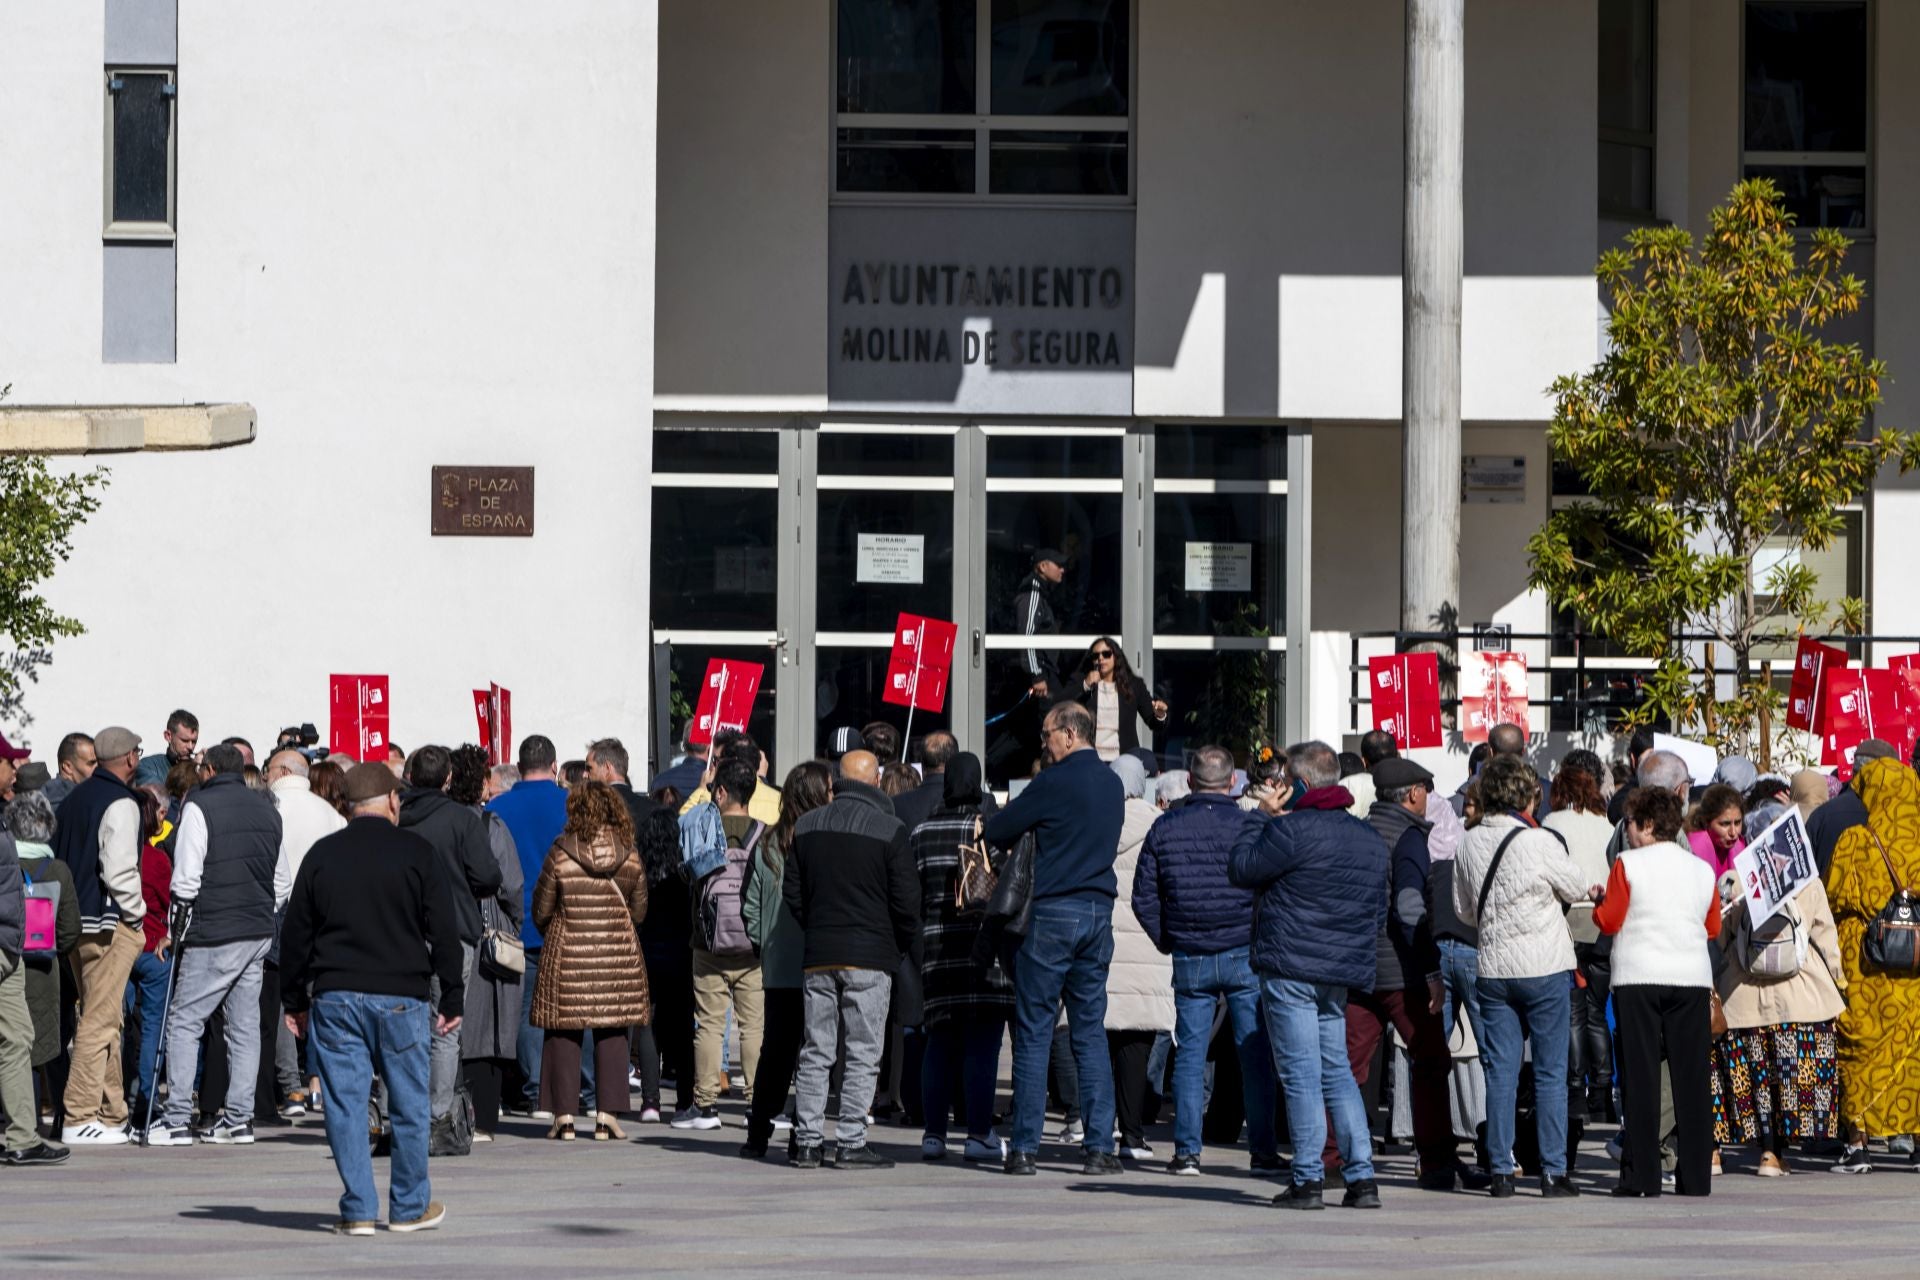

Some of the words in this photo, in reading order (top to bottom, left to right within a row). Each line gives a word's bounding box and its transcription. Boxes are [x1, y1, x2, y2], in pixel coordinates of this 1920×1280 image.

[843, 265, 1121, 308] AYUNTAMIENTO
[842, 328, 950, 362] MOLINA
[963, 331, 997, 366] DE
[1011, 331, 1120, 366] SEGURA
[468, 478, 518, 492] PLAZA
[480, 496, 500, 510] DE
[462, 512, 525, 528] ESPAÑA
